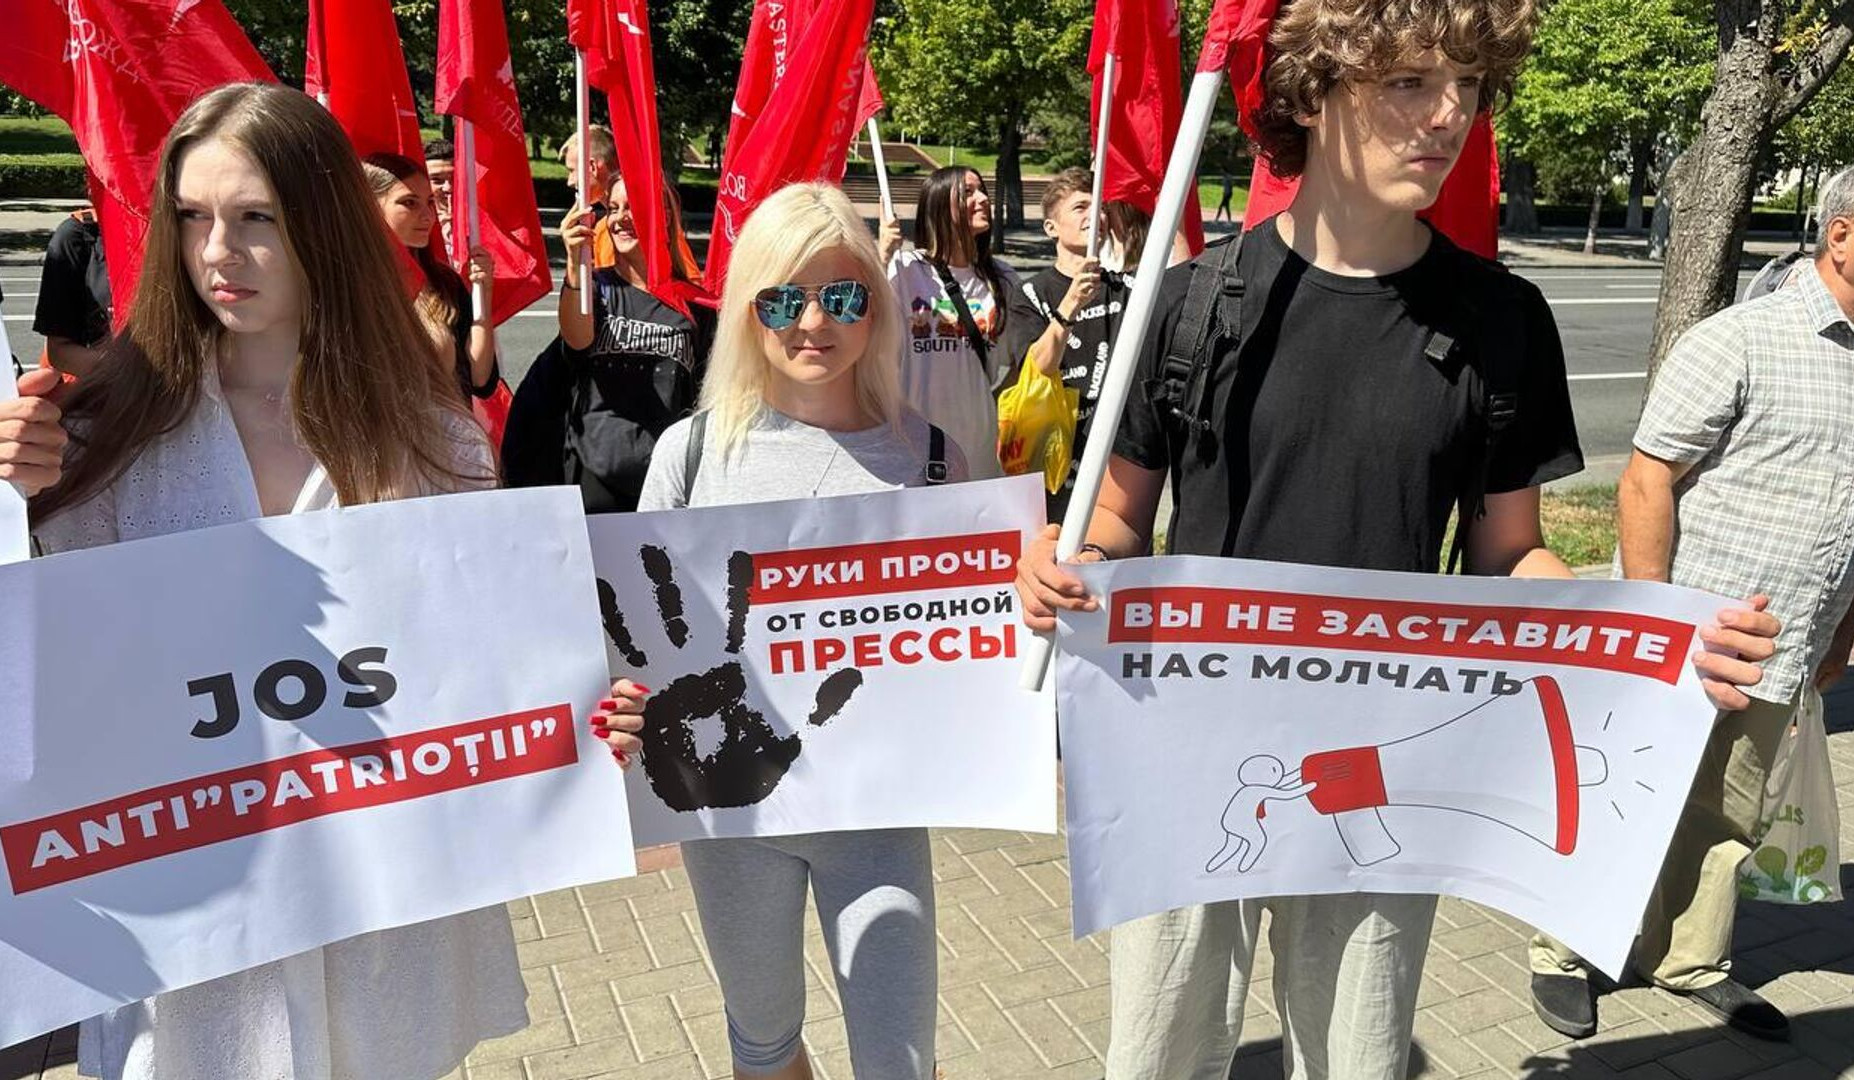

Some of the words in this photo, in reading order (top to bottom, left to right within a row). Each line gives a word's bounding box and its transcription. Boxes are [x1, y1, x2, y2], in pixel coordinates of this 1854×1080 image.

[760, 559, 865, 590] РУКИ
[881, 548, 1014, 579] ПРОЧЬ
[766, 612, 806, 633] ОТ
[818, 591, 1013, 628] СВОБОДНОЙ
[1124, 602, 1202, 630] ВЫ
[1228, 605, 1294, 633] НЕ
[1318, 609, 1672, 664] ЗАСТАВИТЕ
[769, 624, 1017, 674] ПРЕССЫ
[186, 646, 398, 739] JOS
[1122, 652, 1229, 679] НАС
[1252, 655, 1523, 697] МОЛЧАТЬ
